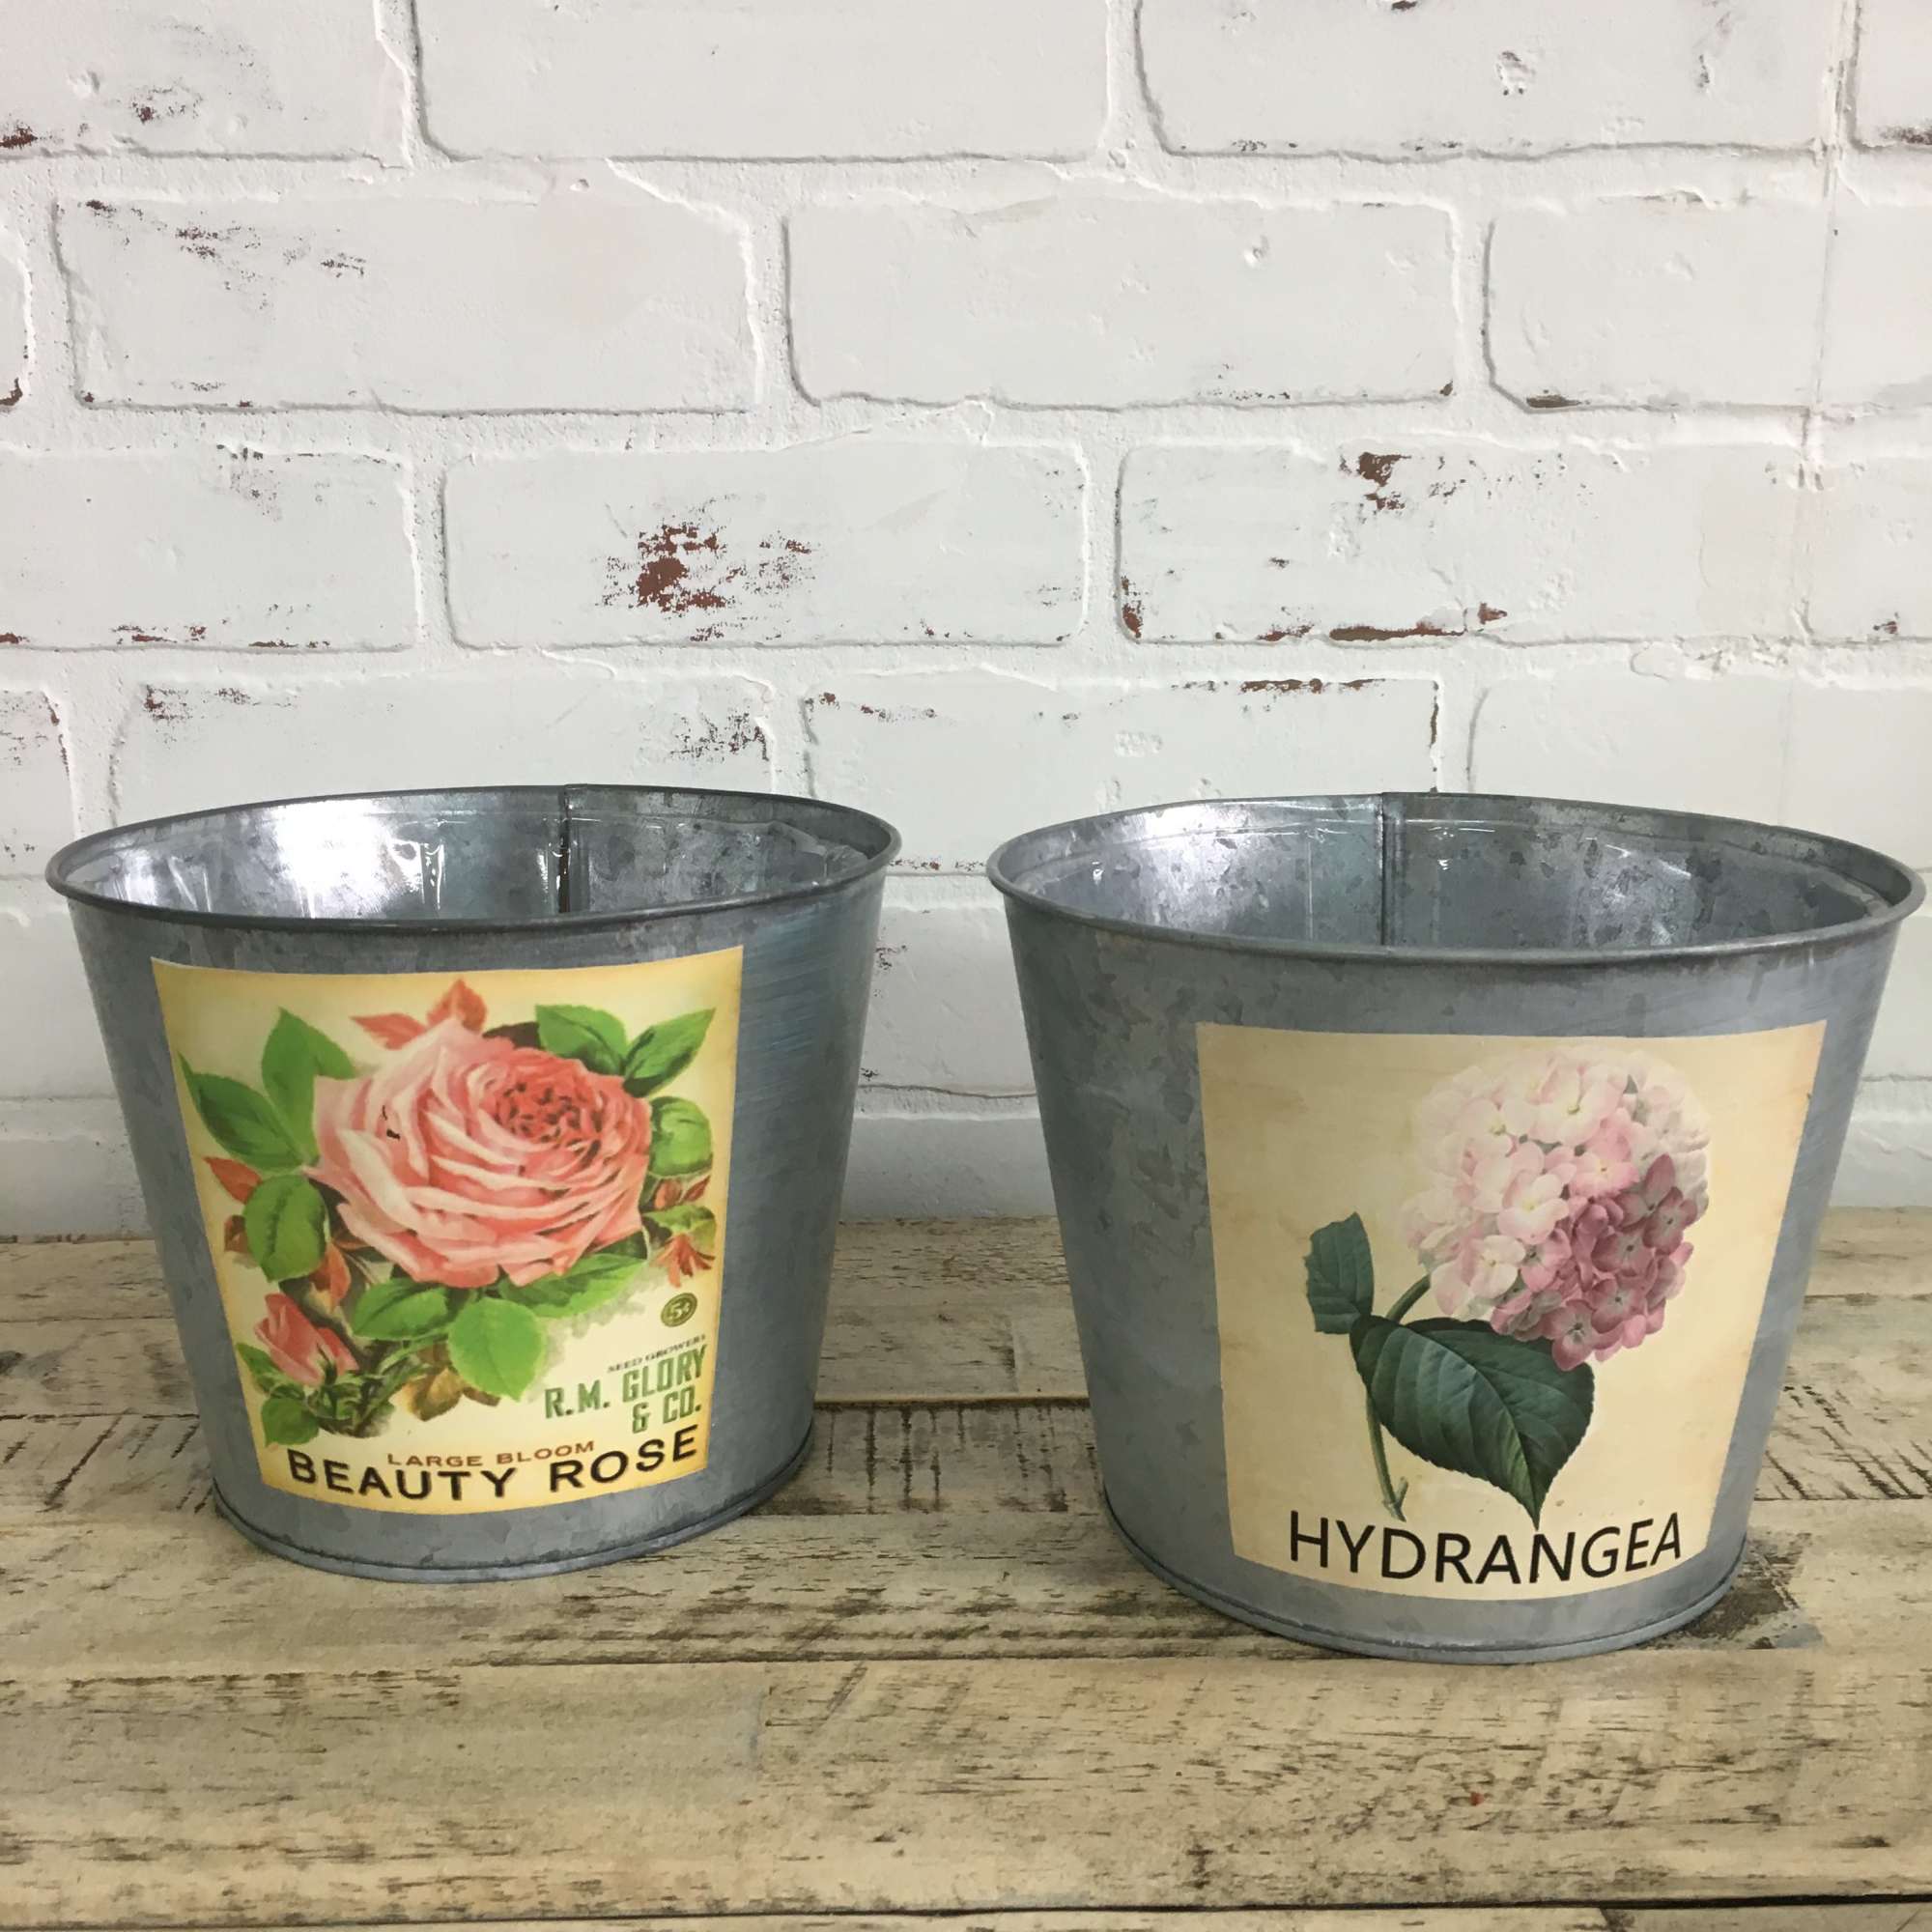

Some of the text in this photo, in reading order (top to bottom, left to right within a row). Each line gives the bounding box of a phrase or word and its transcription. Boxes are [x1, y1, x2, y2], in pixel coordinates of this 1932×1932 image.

[544, 1344, 707, 1419] R.M. GLORY
[632, 1385, 702, 1435] & CO.
[286, 1424, 698, 1501] BEAUTY ROSE
[387, 1440, 595, 1467] LARGE BLOOM
[1290, 1509, 1682, 1585] HYDRANGEA
